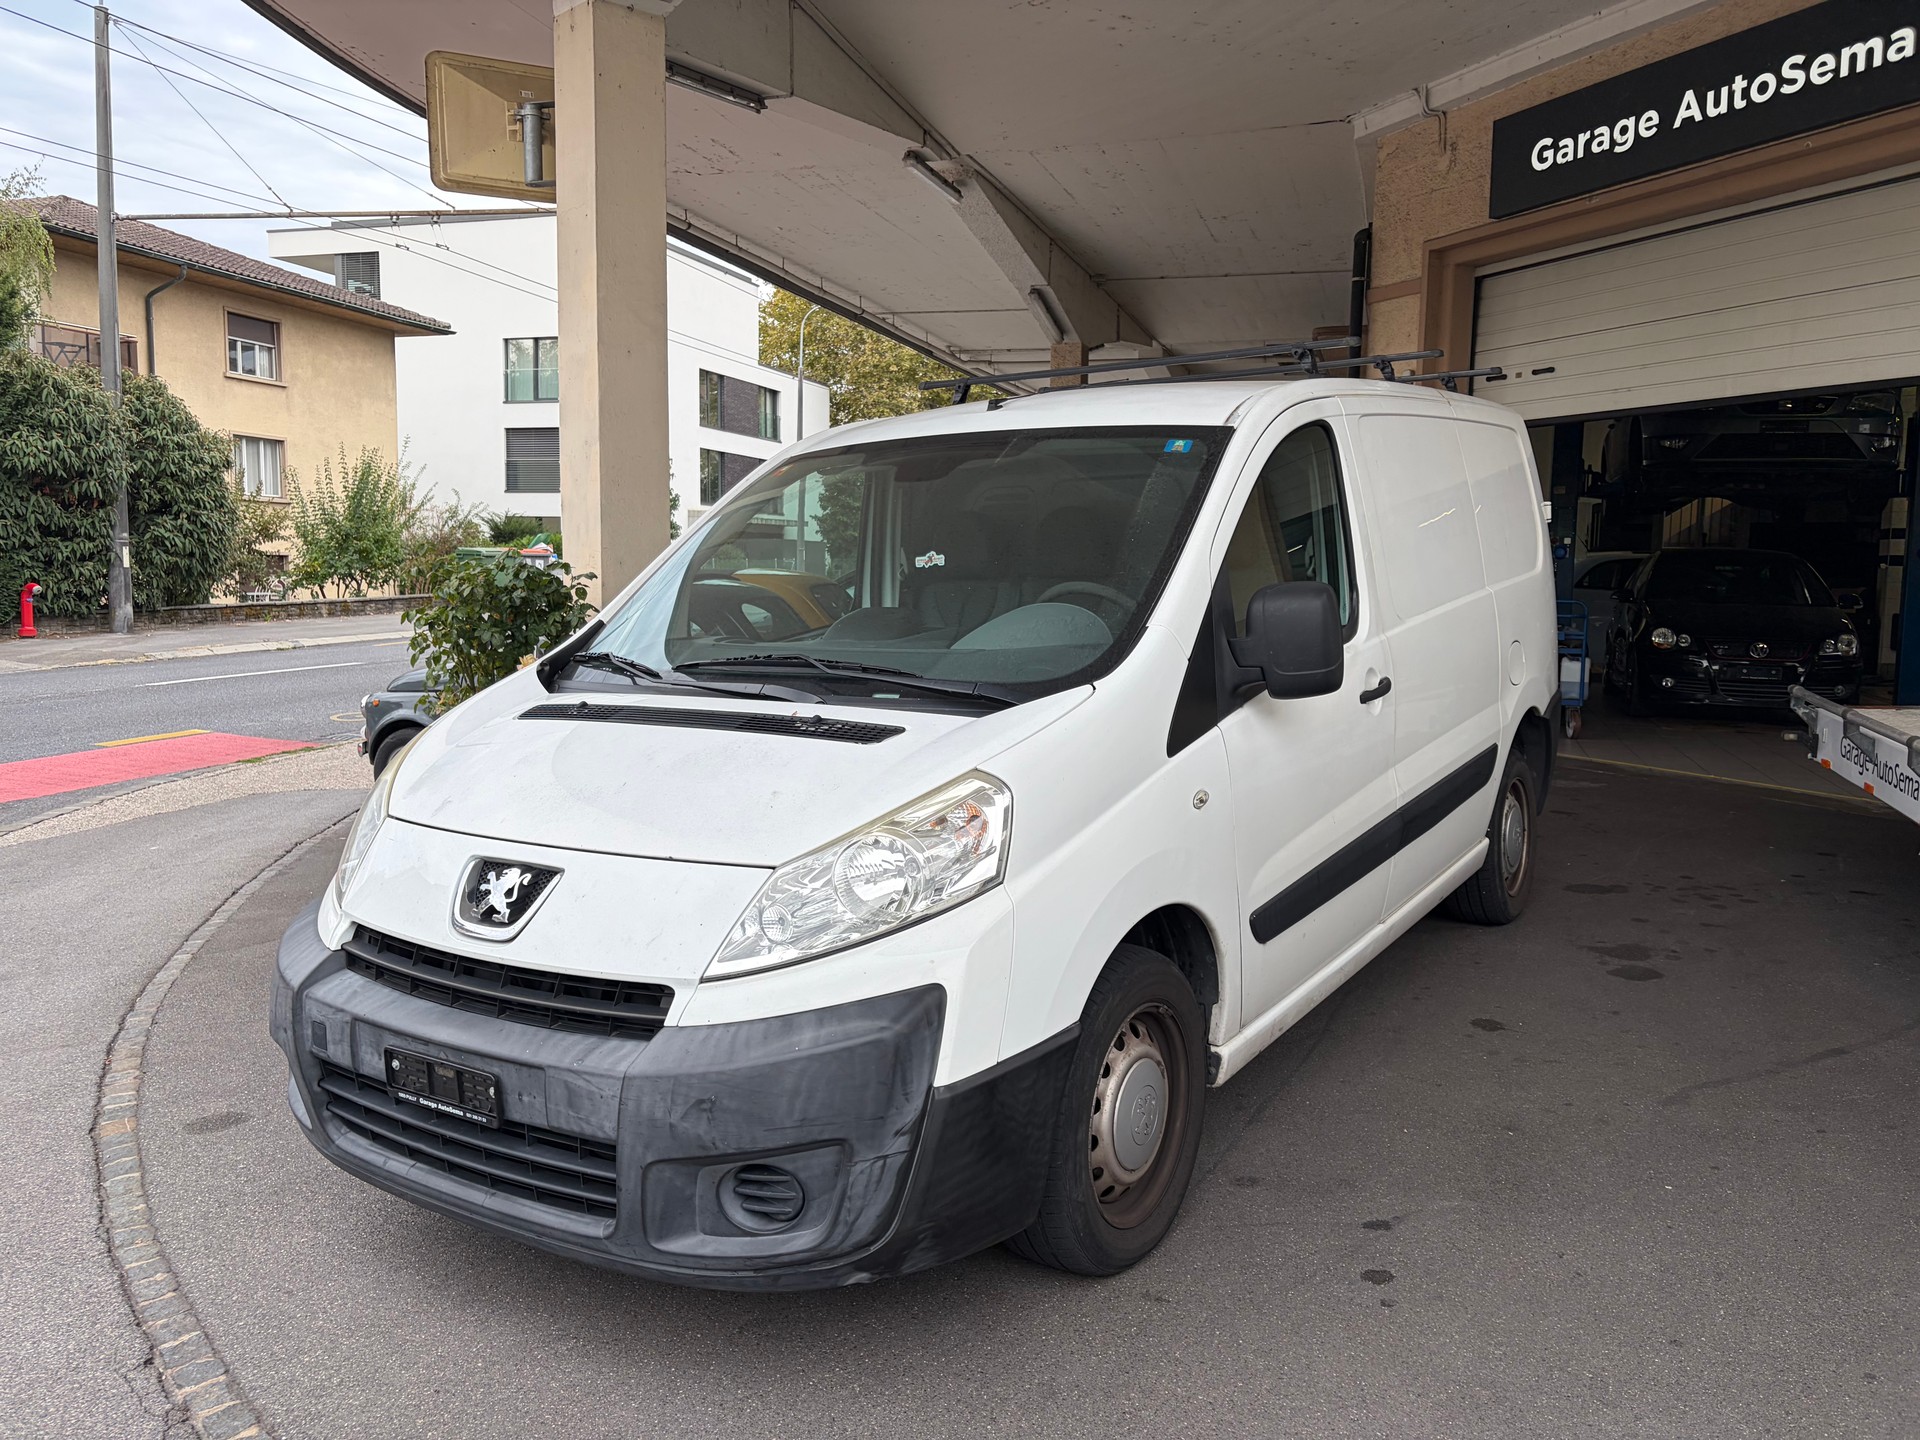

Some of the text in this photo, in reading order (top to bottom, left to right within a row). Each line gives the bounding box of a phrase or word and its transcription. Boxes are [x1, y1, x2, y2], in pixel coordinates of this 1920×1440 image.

[1531, 26, 1917, 171] Garage AutoSema
[1841, 737, 1920, 801] Garage AutoSema
[419, 1097, 438, 1109] Garage
